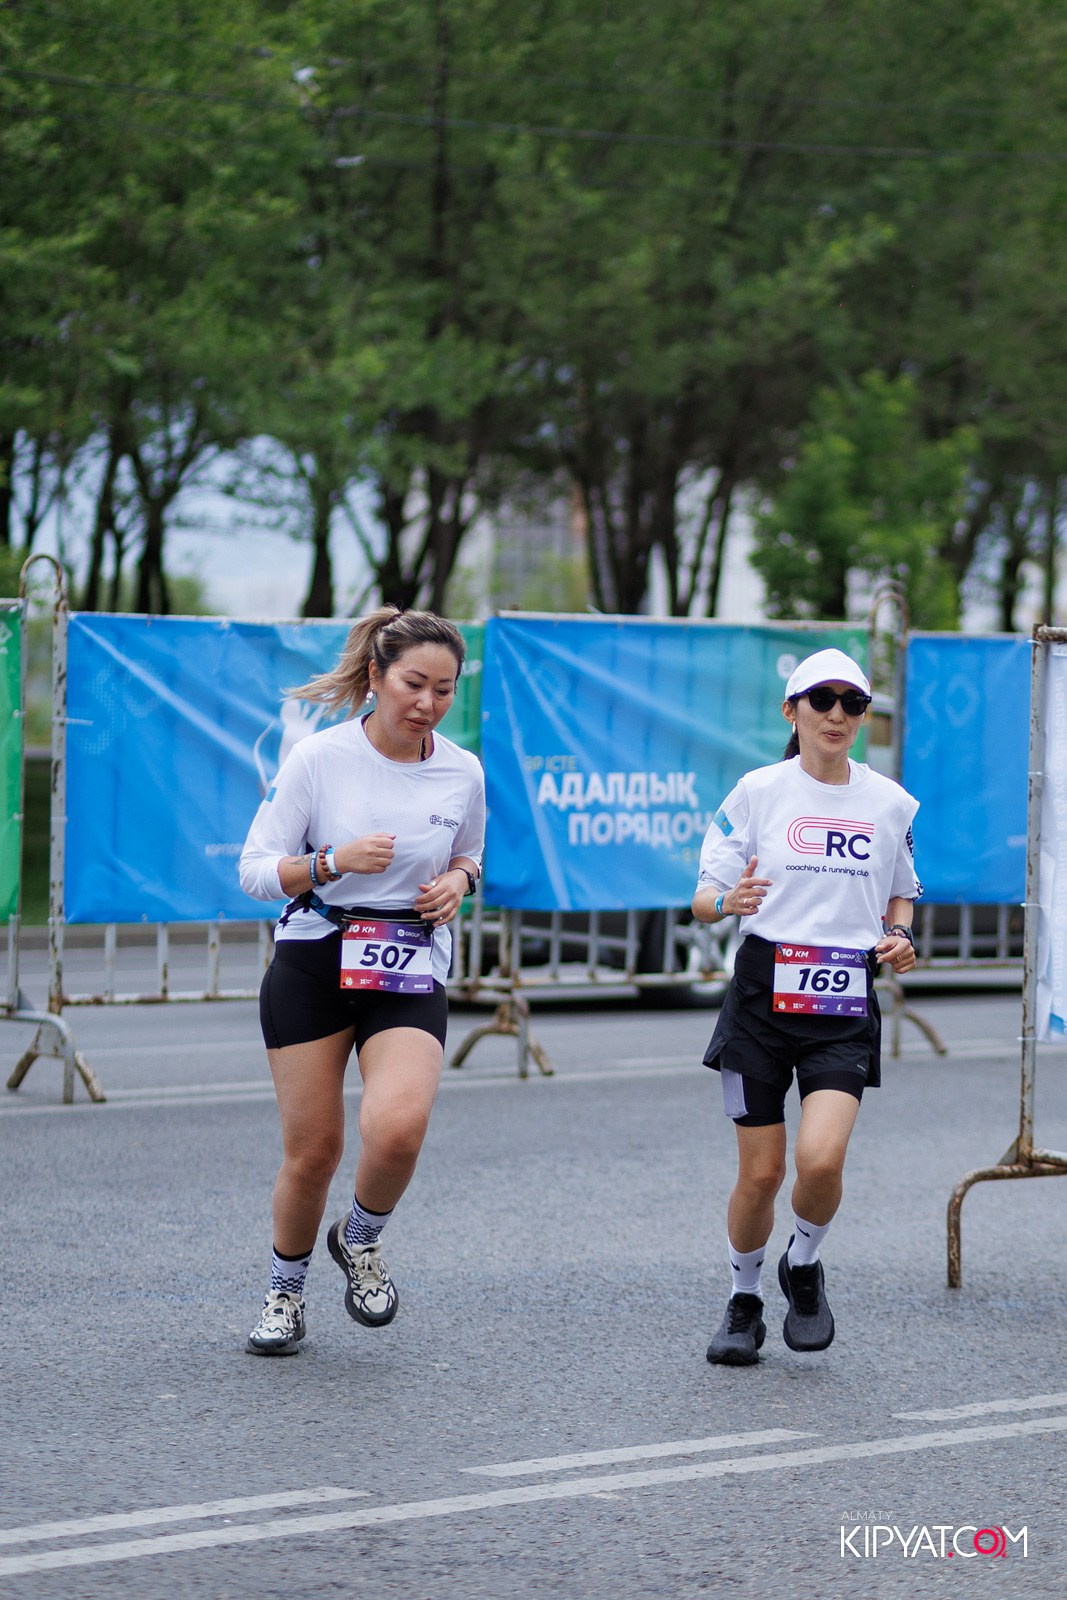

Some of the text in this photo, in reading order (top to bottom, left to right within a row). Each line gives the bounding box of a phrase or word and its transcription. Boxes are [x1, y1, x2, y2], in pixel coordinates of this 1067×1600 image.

[537, 772, 698, 811] АДАЛДЫҚ
[785, 864, 870, 877] coaching & running club
[348, 924, 361, 933] 10
[359, 943, 417, 970] 507
[798, 968, 850, 993] 169
